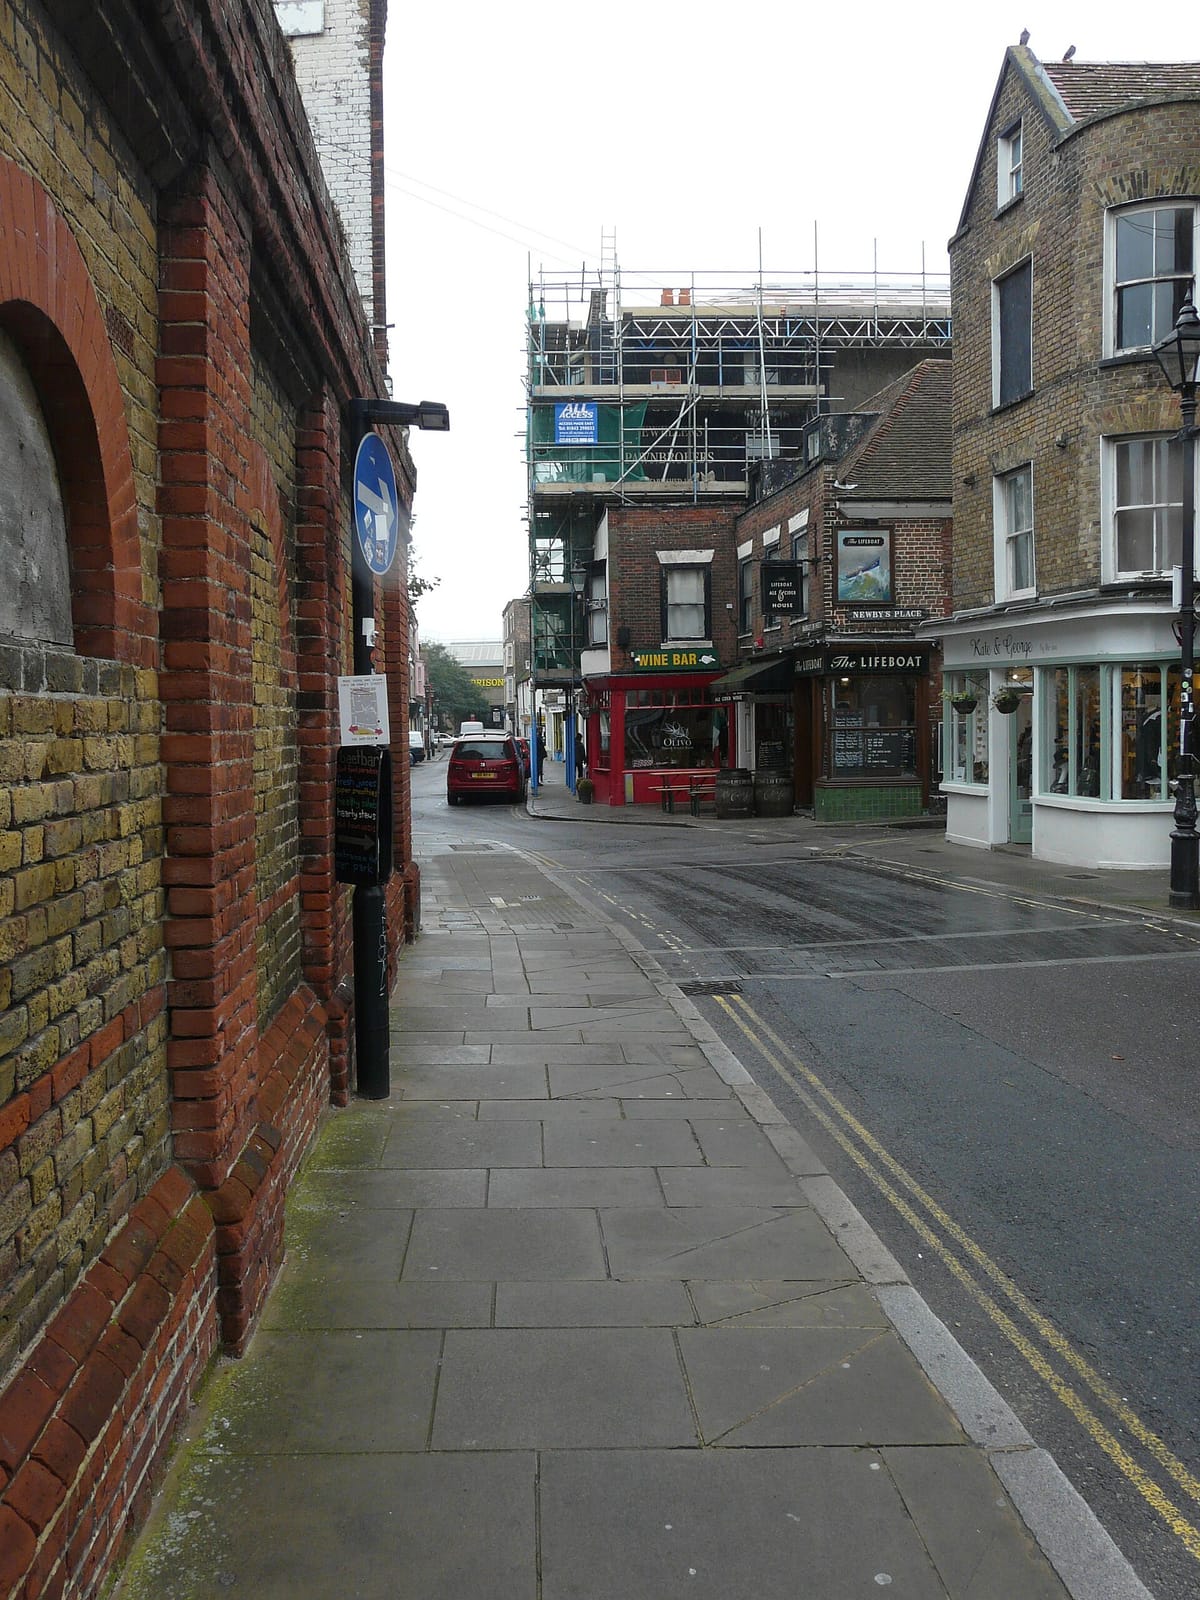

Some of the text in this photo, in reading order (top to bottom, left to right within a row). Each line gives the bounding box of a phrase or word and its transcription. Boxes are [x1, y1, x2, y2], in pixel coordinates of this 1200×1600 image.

[562, 403, 587, 413] ALL
[1002, 634, 1033, 659] George
[639, 653, 697, 666] WINE BAR
[830, 656, 922, 668] The LIFEBOAT
[663, 738, 692, 747] OLIVO
